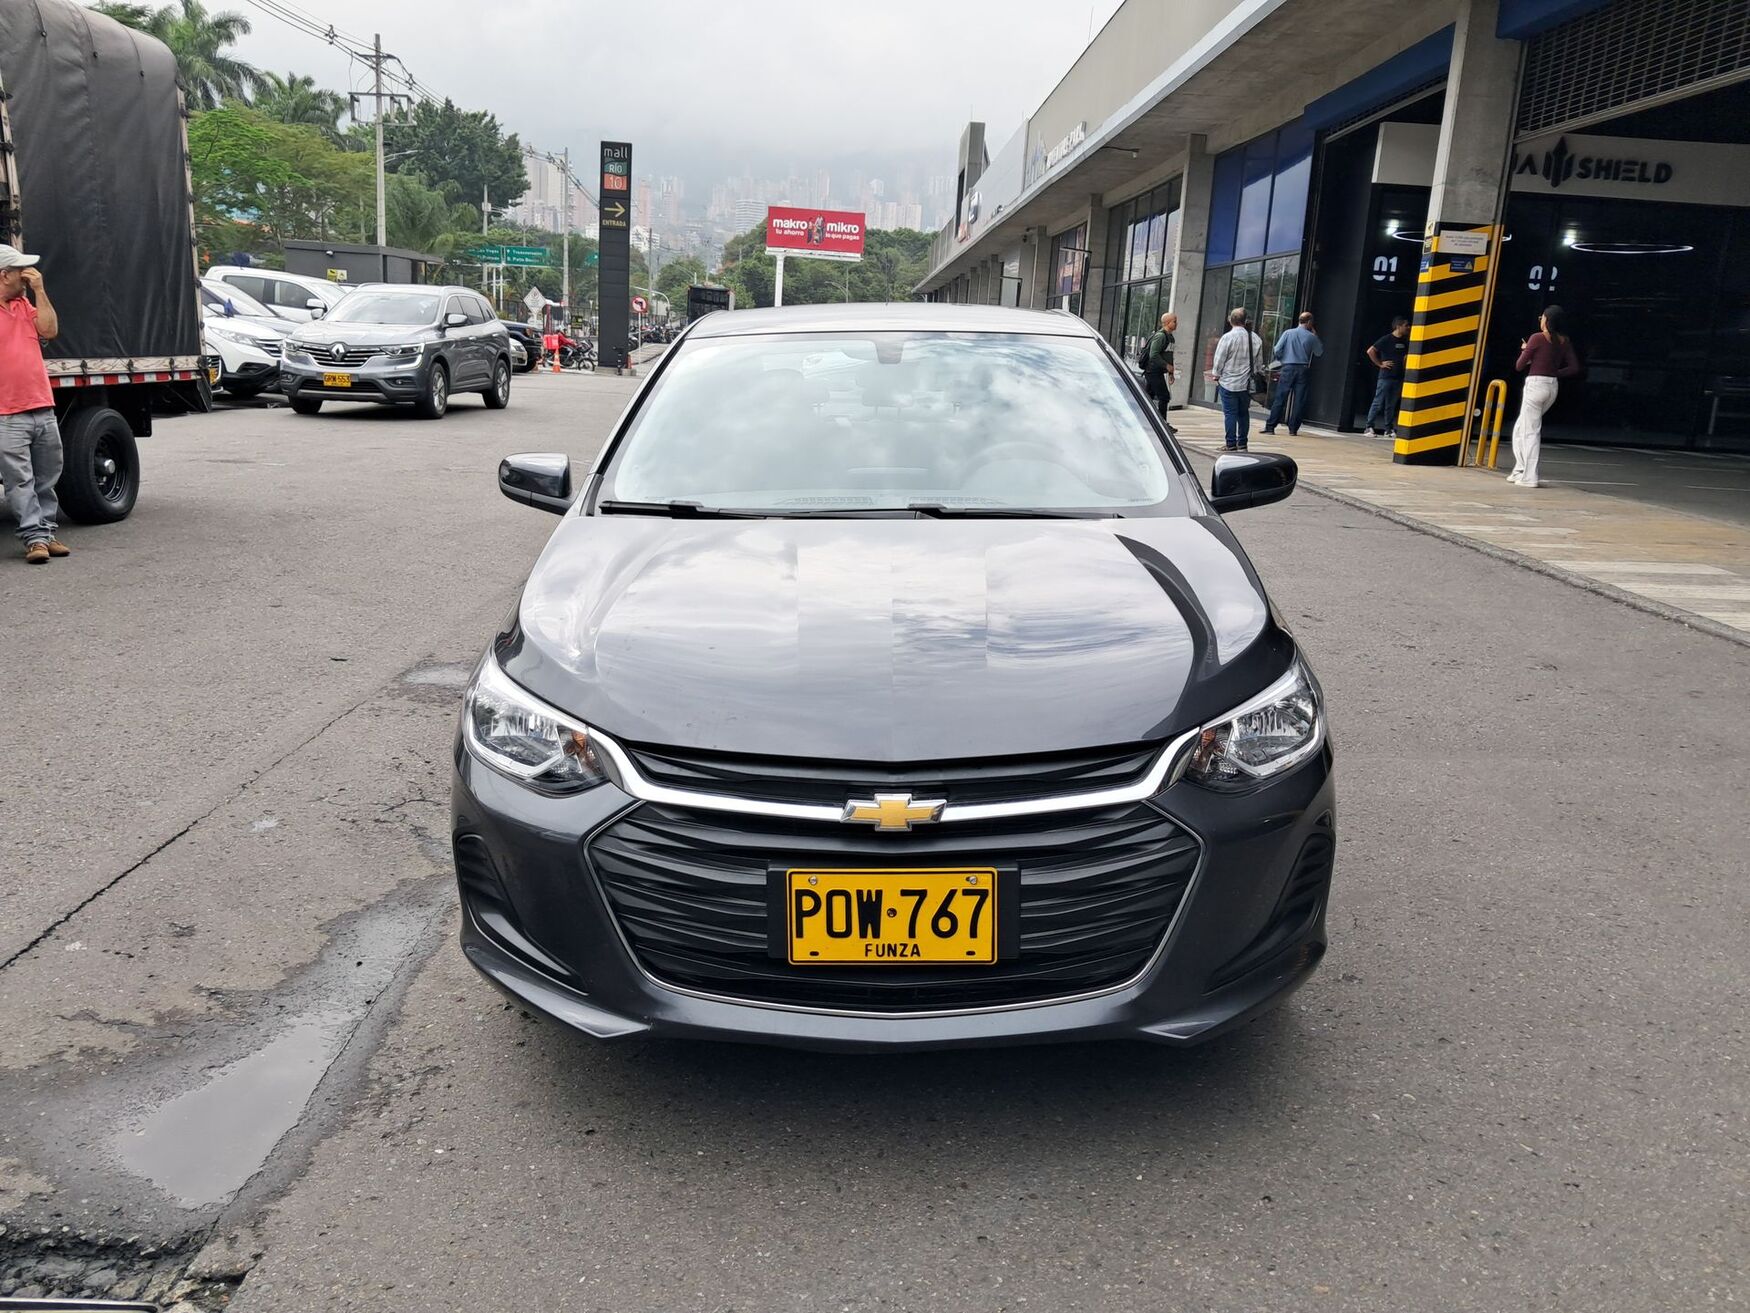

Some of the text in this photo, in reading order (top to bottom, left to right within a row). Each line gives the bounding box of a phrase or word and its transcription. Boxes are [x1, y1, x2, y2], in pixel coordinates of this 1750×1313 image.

[603, 147, 628, 158] mall
[1576, 156, 1674, 184] SHIELD
[609, 175, 623, 189] 10
[602, 219, 627, 227] ENTRADA
[772, 218, 808, 230] makro
[826, 222, 859, 234] mikro
[1373, 255, 1398, 282] 01
[795, 888, 989, 939] POW 767
[864, 943, 921, 957] FUNZA
